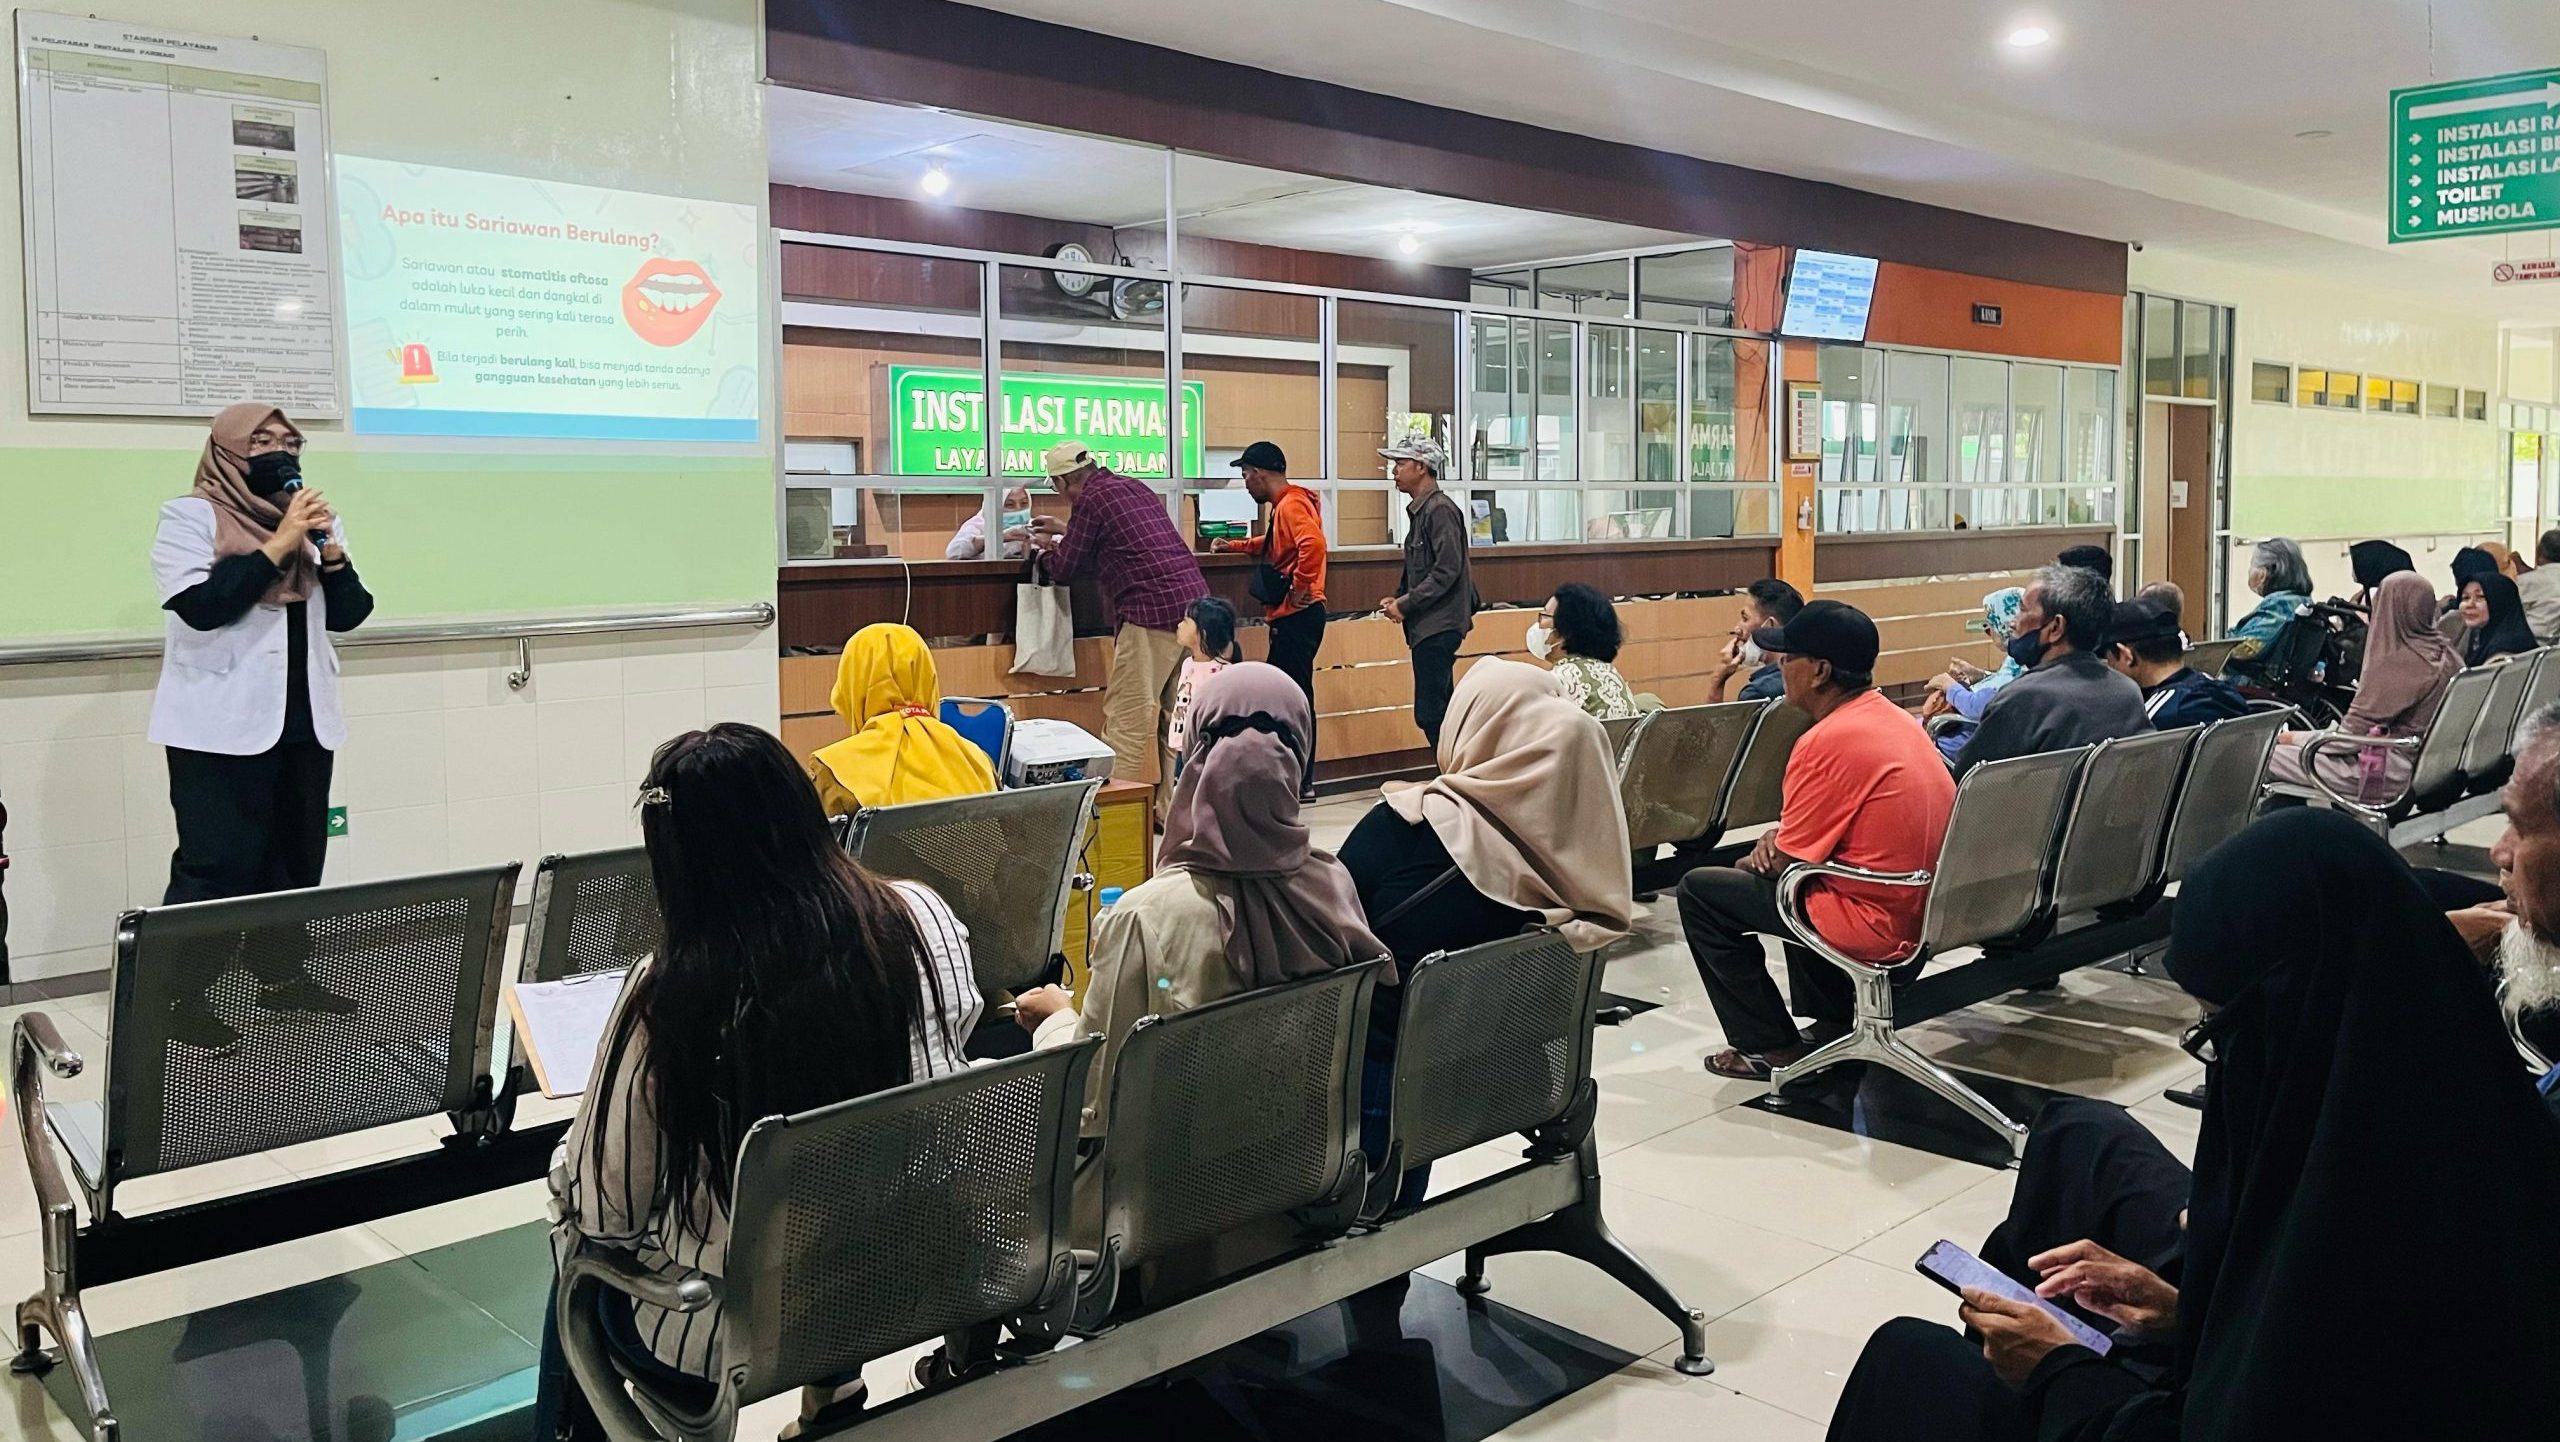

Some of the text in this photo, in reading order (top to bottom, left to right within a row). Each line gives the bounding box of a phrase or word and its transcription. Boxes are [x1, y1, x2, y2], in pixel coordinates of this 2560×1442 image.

[2438, 117, 2536, 144] INSTALASI
[2438, 138, 2536, 164] INSTALASI
[2438, 159, 2536, 185] INSTALASI
[2436, 184, 2504, 205] TOILET
[2438, 201, 2536, 226] MUSHOLA
[383, 204, 659, 251] Apa itu Sariawan Berulang?
[402, 257, 609, 286] Sariawan atau stomatitis aftosa
[2522, 262, 2555, 270] KAWASAN
[412, 280, 602, 305] adalah luka kecil dan dangkal di
[400, 299, 614, 325] dalam mulut yang sering kali terasa
[496, 325, 528, 338] perih.
[438, 351, 458, 362] Bila
[461, 353, 497, 366] terjadi
[500, 354, 552, 369] berulang
[580, 358, 600, 370] bisa
[603, 361, 642, 373] menjadi
[645, 364, 673, 374] tanda
[676, 366, 710, 376] adanya
[475, 373, 535, 384] gangguan
[538, 374, 596, 386] kesehatan
[599, 379, 623, 389] yang
[626, 378, 649, 388] lebih
[911, 388, 1189, 438] INSTLASI FARMAI
[935, 447, 1033, 472] LAYAAN
